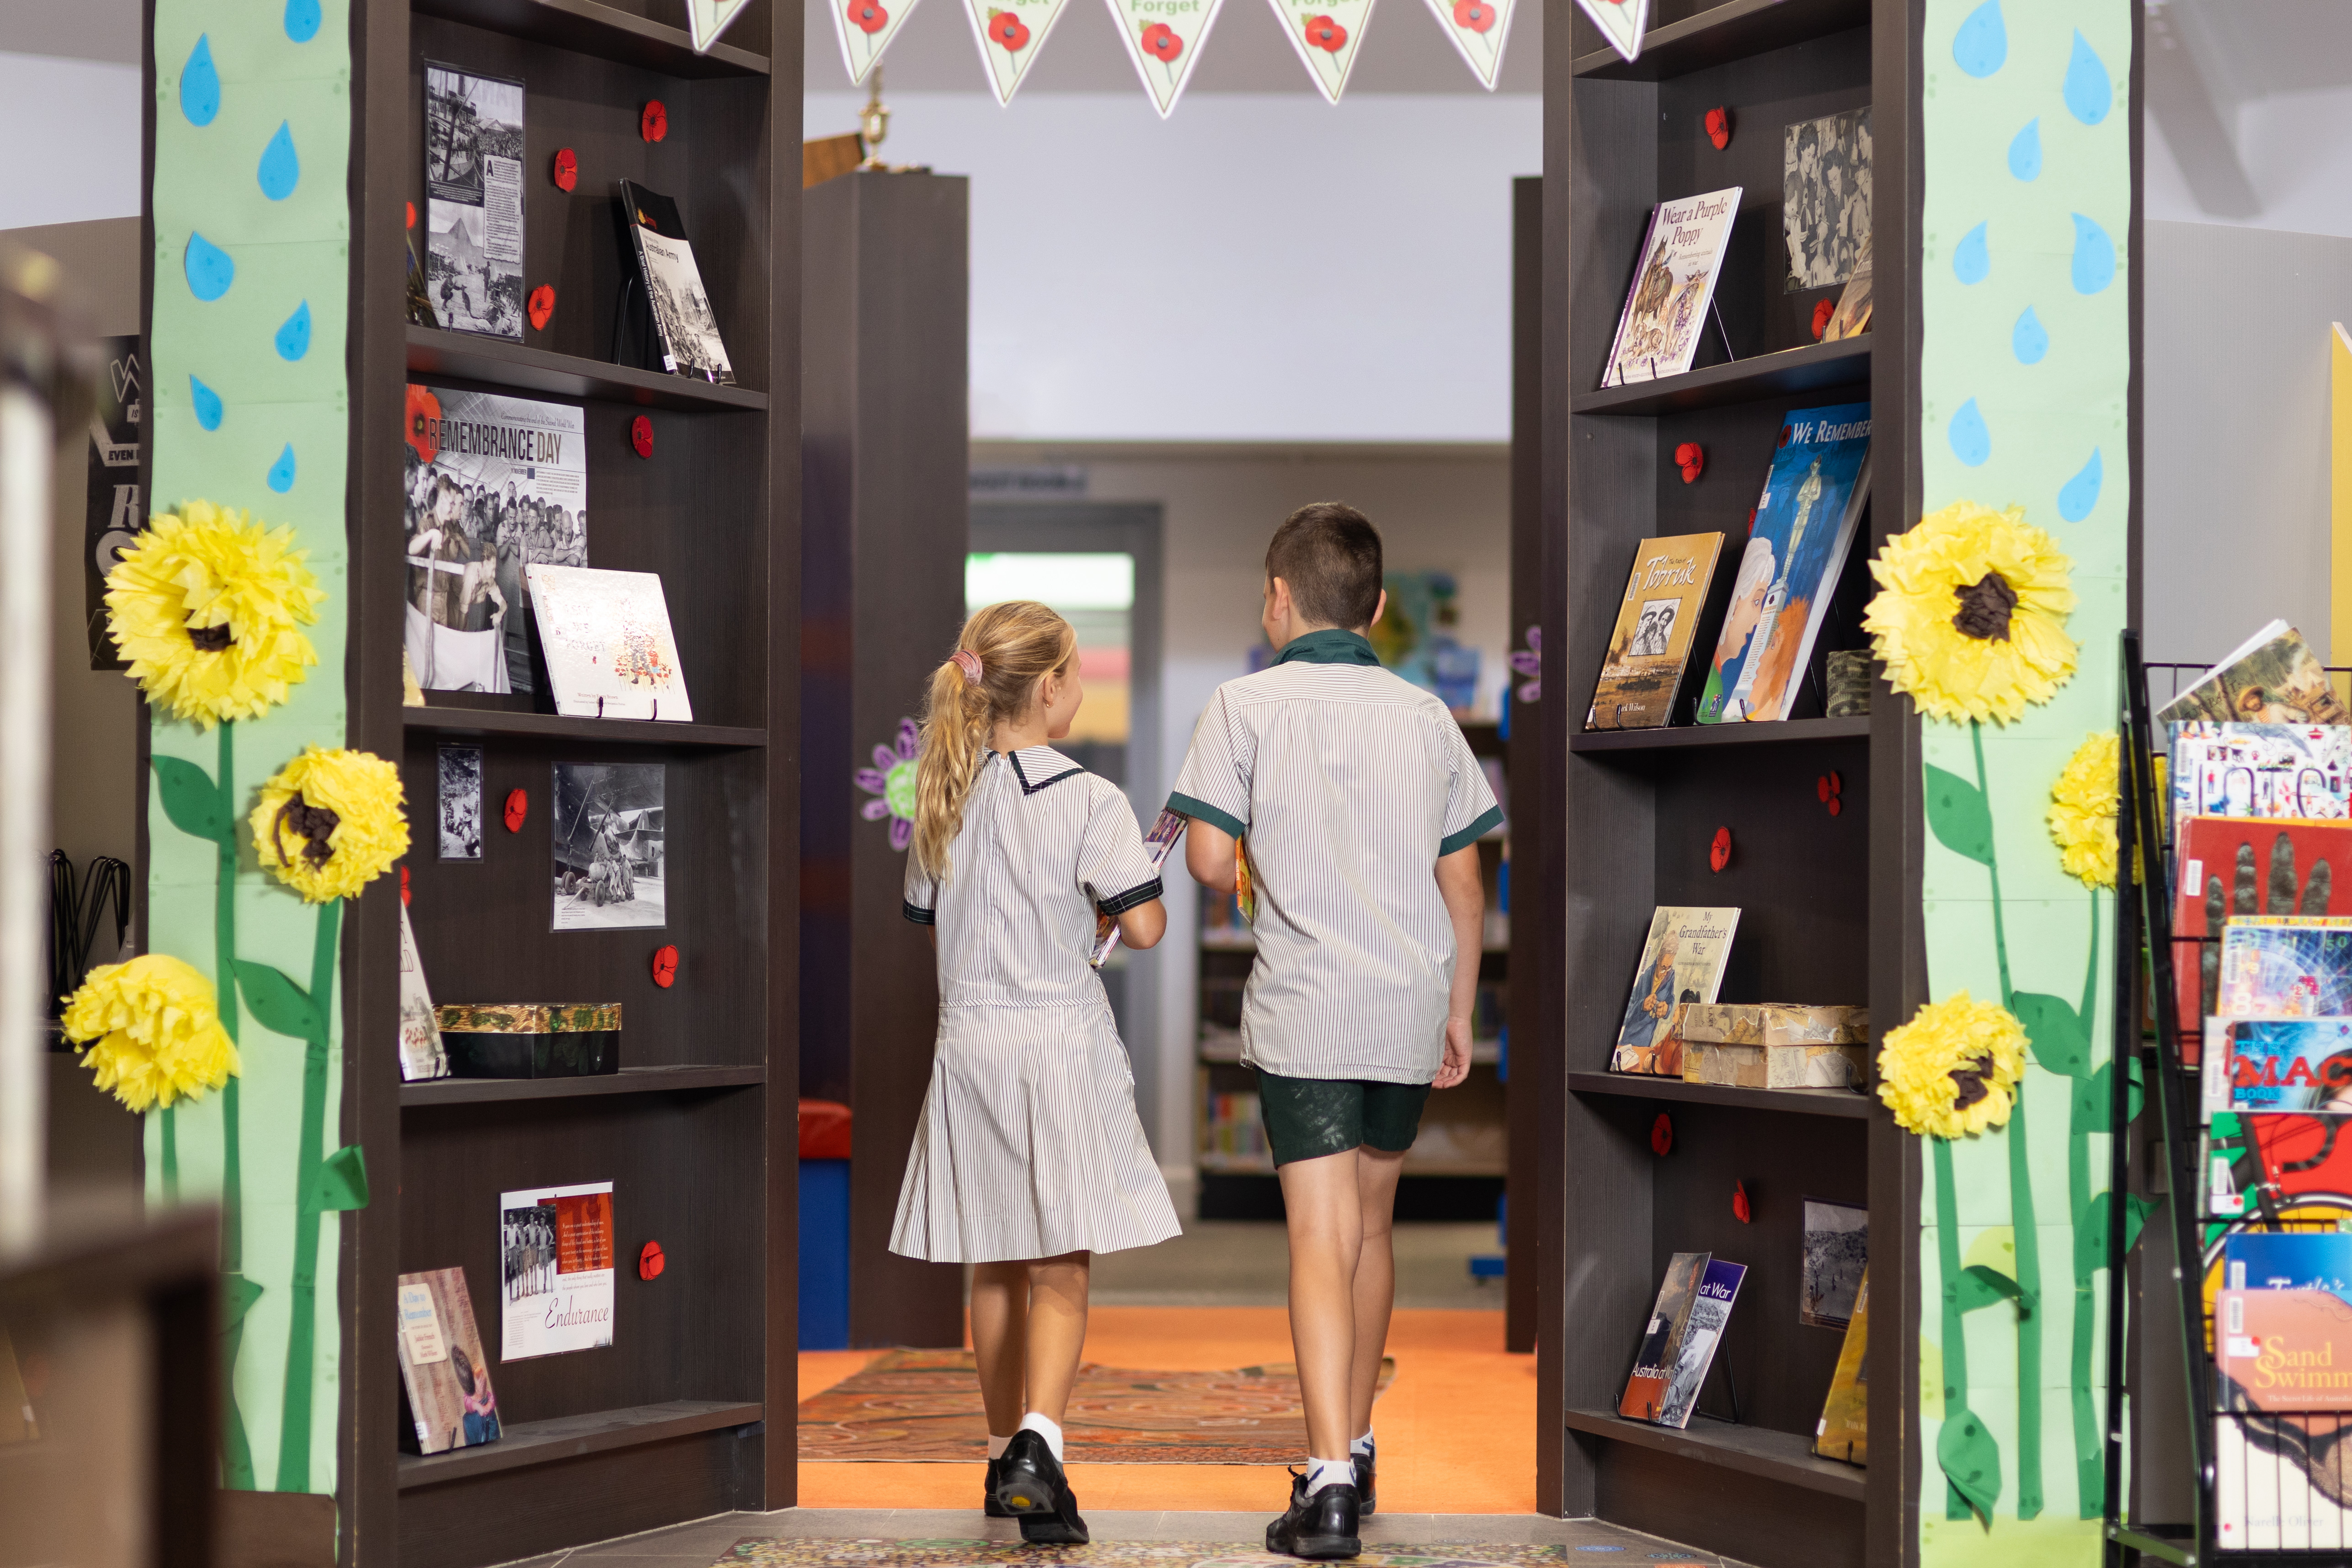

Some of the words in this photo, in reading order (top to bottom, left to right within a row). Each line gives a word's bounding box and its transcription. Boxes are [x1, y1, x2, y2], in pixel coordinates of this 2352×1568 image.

[1131, 0, 1200, 16] Forget
[1663, 207, 1687, 226] Wear
[1686, 209, 1693, 221] a
[1694, 197, 1727, 220] Purple
[1671, 226, 1703, 247] Poppy
[645, 240, 666, 257] Australian
[666, 249, 678, 263] Army
[642, 267, 651, 285] History
[651, 300, 660, 324] Australian
[501, 412, 526, 424] Commemorating
[537, 415, 541, 426] of
[545, 416, 556, 426] Second
[556, 418, 566, 428] World
[429, 417, 534, 461] REMEMBRANCE
[537, 431, 561, 464] DAY
[1792, 421, 1813, 445] WE
[108, 450, 133, 461] EVEN
[1643, 555, 1697, 591] Tobruk
[1629, 703, 1646, 712] Wilson
[1703, 912, 1713, 923] My
[1680, 925, 1727, 939] Grandfather's
[1692, 943, 1706, 955] War
[2232, 992, 2252, 1015] 8
[2235, 1040, 2281, 1055] THE
[2234, 1088, 2280, 1100] BOOK
[404, 1294, 408, 1303] A
[408, 1292, 419, 1303] Day
[1700, 1284, 1711, 1295] at
[1711, 1282, 1732, 1299] War
[404, 1306, 432, 1320] Remember
[545, 1295, 608, 1328] Endurance
[2266, 1336, 2332, 1369] Sand
[1631, 1362, 1659, 1379] Australia
[1659, 1367, 1666, 1379] at
